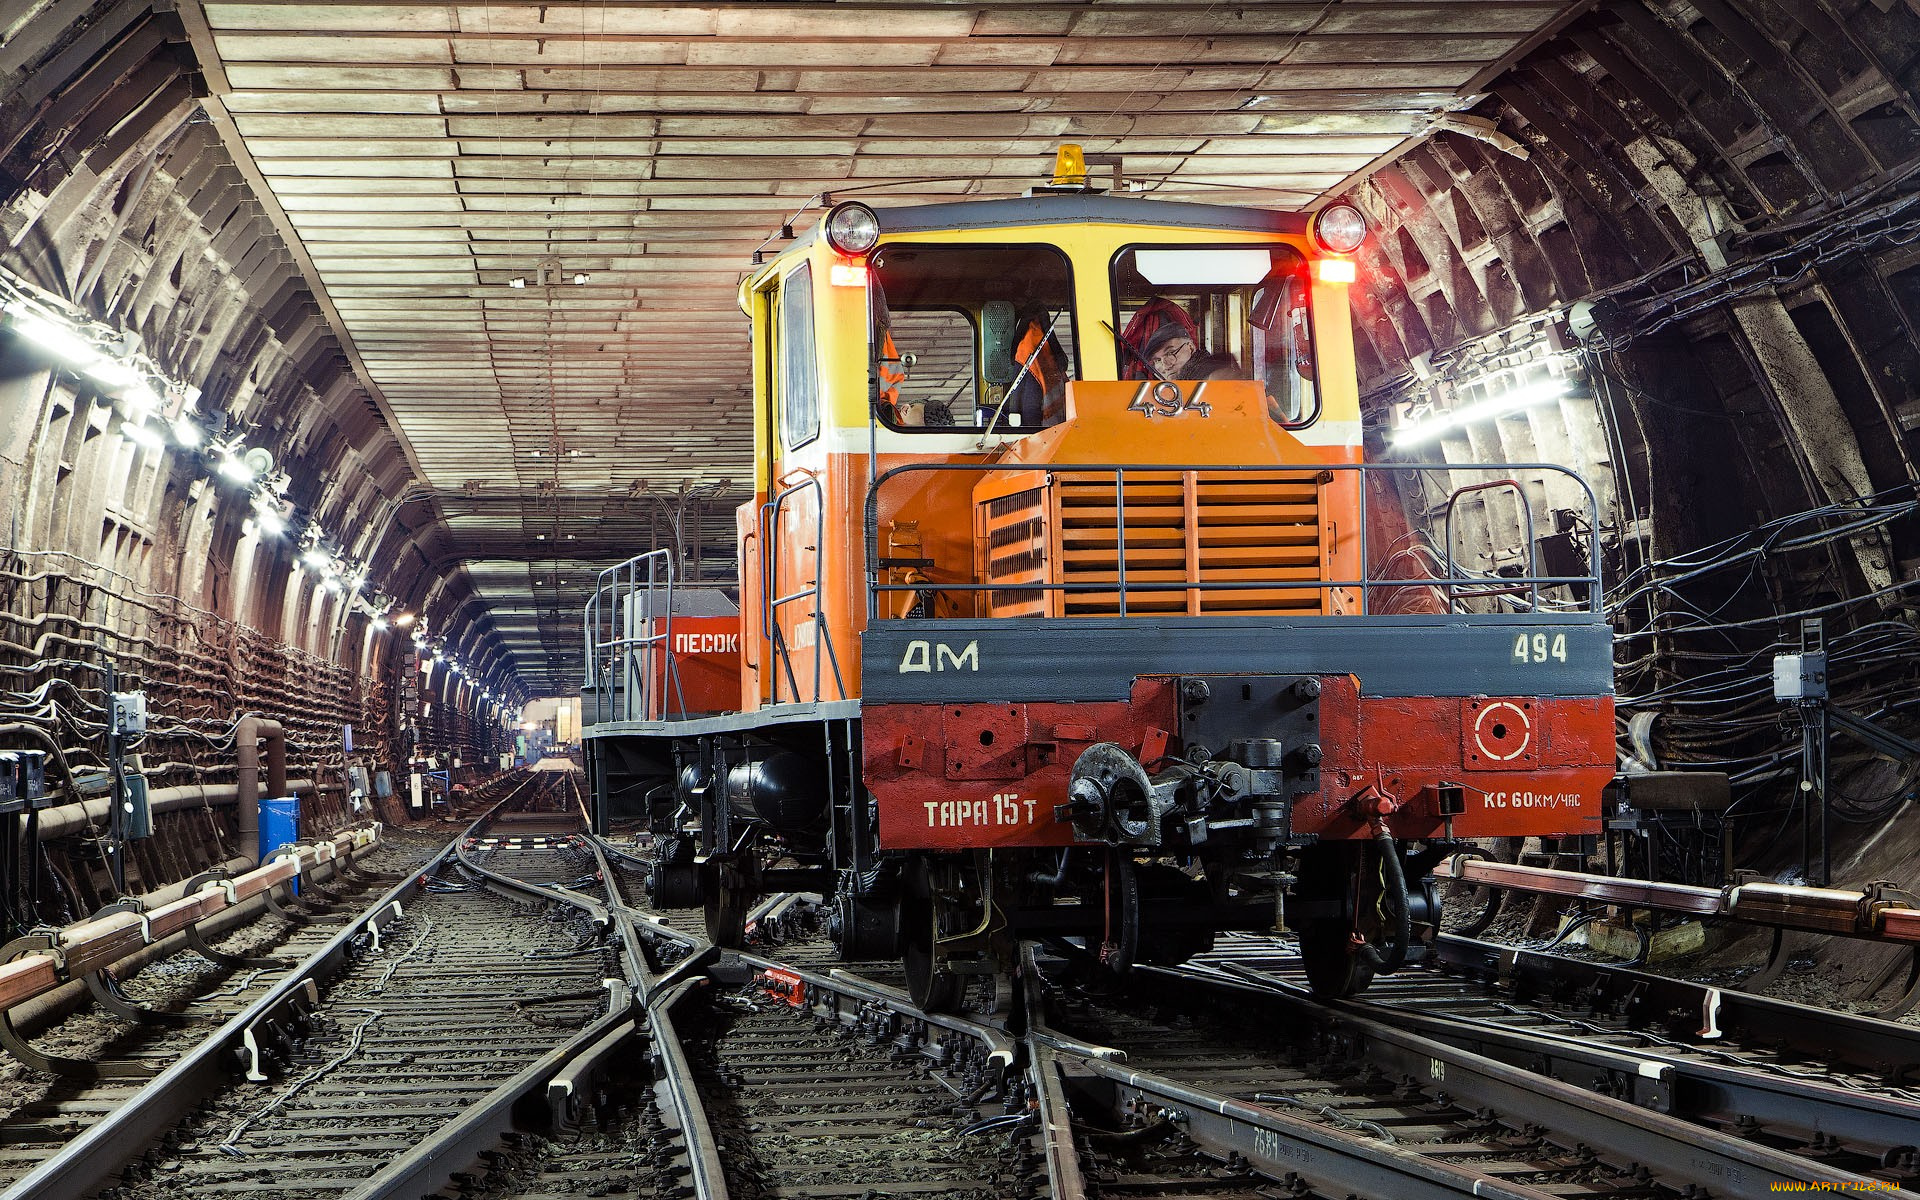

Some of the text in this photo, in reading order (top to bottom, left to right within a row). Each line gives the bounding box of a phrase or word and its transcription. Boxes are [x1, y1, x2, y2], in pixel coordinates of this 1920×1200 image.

[1127, 381, 1212, 417] 494
[675, 633, 738, 653] ПЕСОК
[899, 639, 979, 673] ДМ
[1514, 632, 1567, 663] 494
[923, 800, 988, 827] ТАРА
[993, 793, 1019, 825] 15
[1484, 791, 1507, 808] КС
